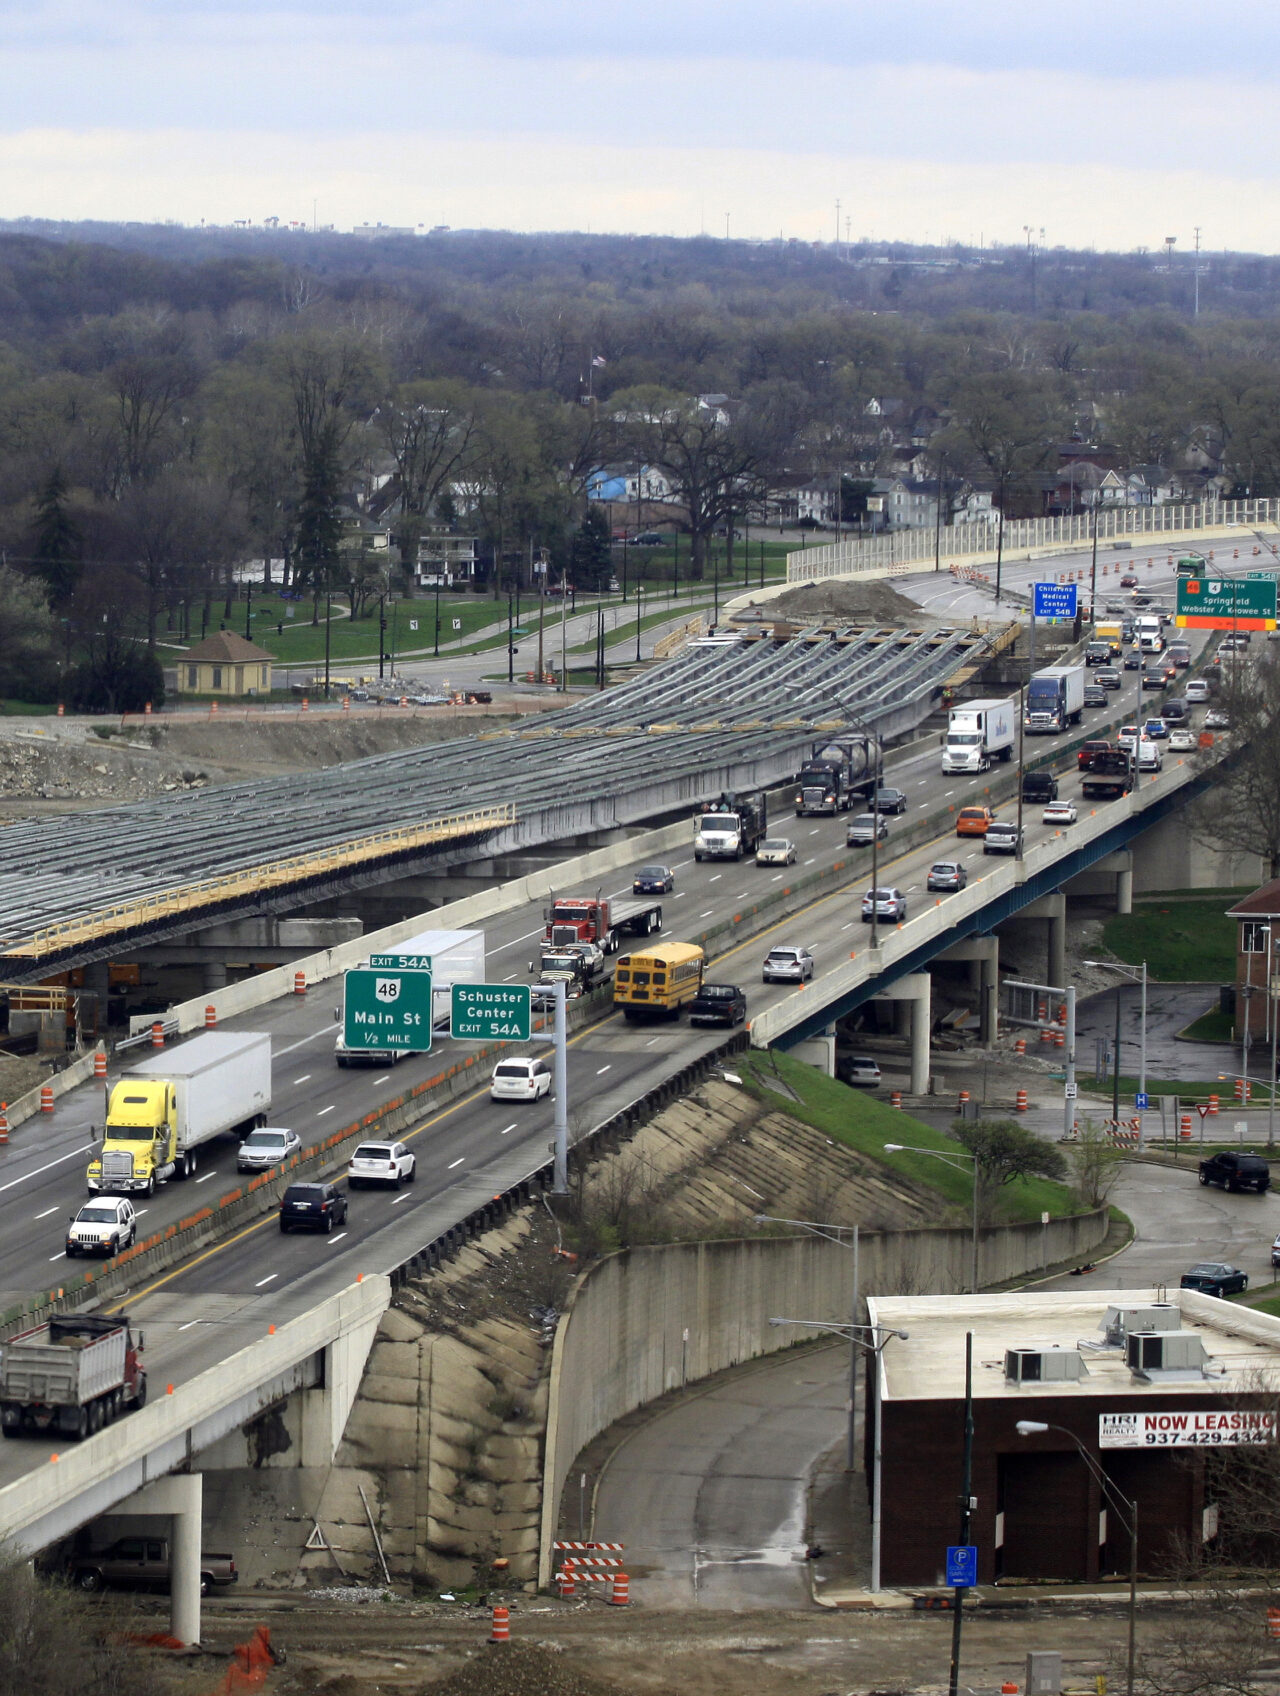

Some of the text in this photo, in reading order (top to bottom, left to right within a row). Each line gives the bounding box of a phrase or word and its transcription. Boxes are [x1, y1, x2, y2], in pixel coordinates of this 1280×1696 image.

[1203, 597, 1249, 606] Springfeld
[1227, 607, 1259, 615] Kowee
[371, 956, 430, 969] EXIT 54A
[378, 983, 397, 997] 48
[458, 990, 523, 1003] Schuster
[354, 1011, 421, 1025] Main St
[467, 1006, 514, 1019] Center
[459, 1023, 521, 1035] EXIT 54A
[387, 1034, 411, 1044] MILE
[1137, 1095, 1145, 1105] H
[1103, 1415, 1137, 1424] HRI
[1144, 1414, 1275, 1430] NOW LEASING
[1145, 1432, 1273, 1444] 937-429-434
[958, 1552, 967, 1562] P
